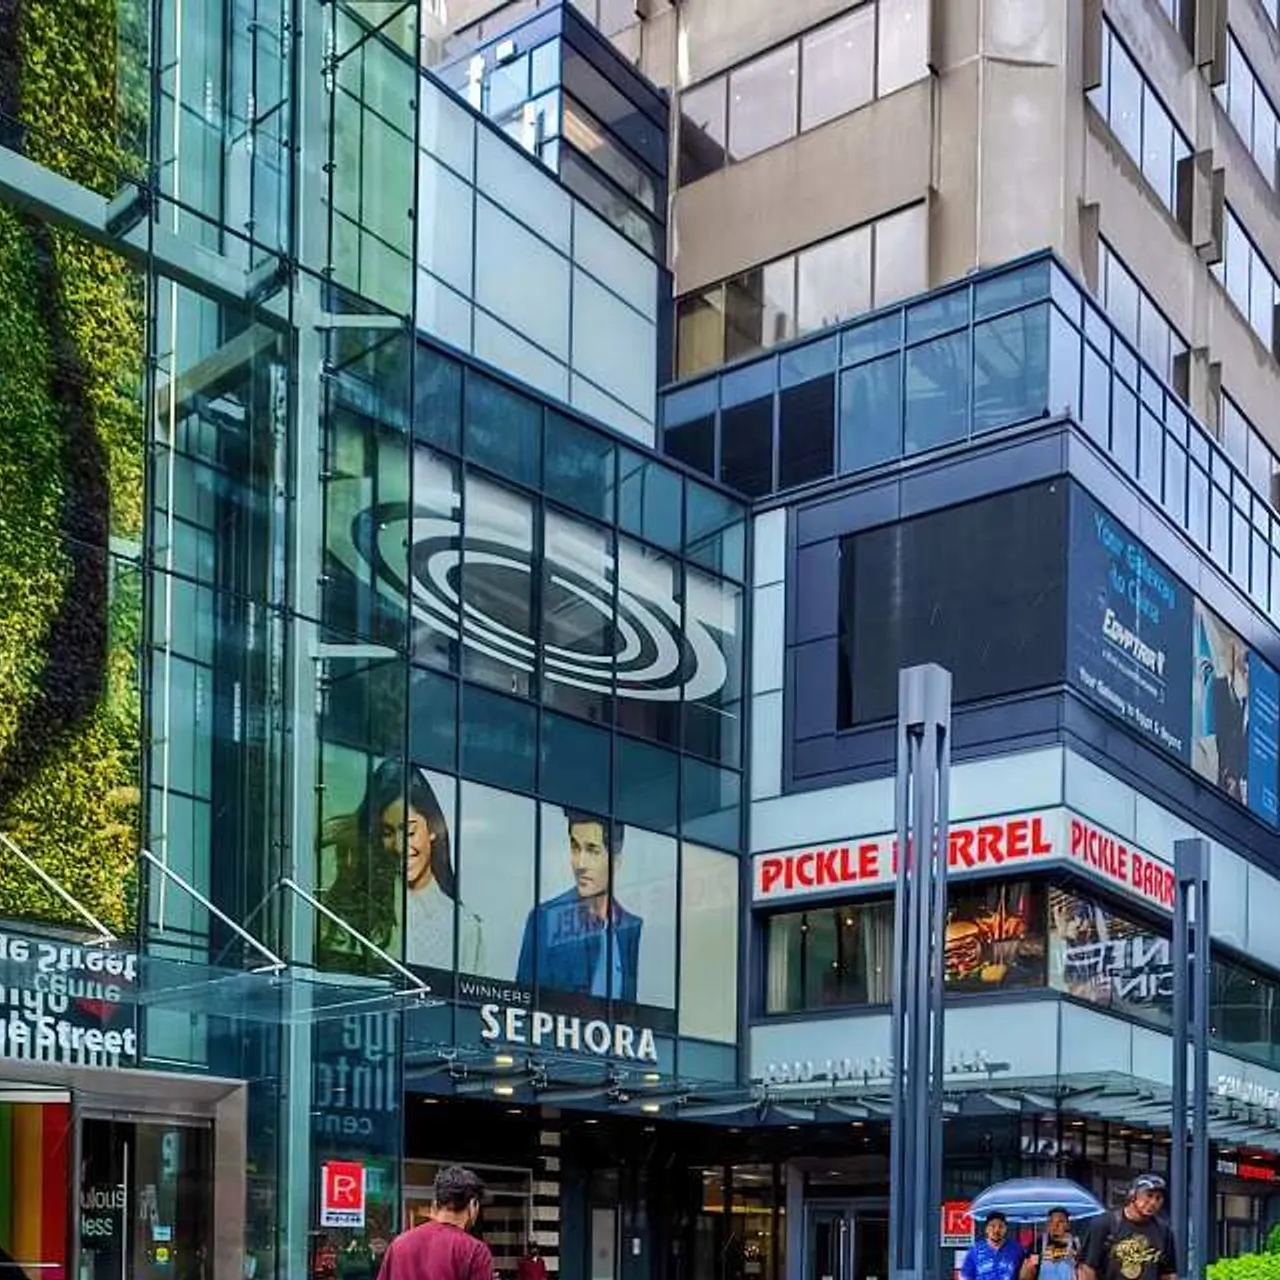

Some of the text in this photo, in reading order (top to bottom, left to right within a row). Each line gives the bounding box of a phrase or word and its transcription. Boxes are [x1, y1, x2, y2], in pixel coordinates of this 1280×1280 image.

[761, 843, 880, 894] PICKLE
[1070, 817, 1128, 881] PICKLE
[459, 980, 532, 1005] WINNERS
[36, 1015, 136, 1055] Street
[481, 1003, 658, 1063] SEPHORA
[333, 1174, 357, 1203] R
